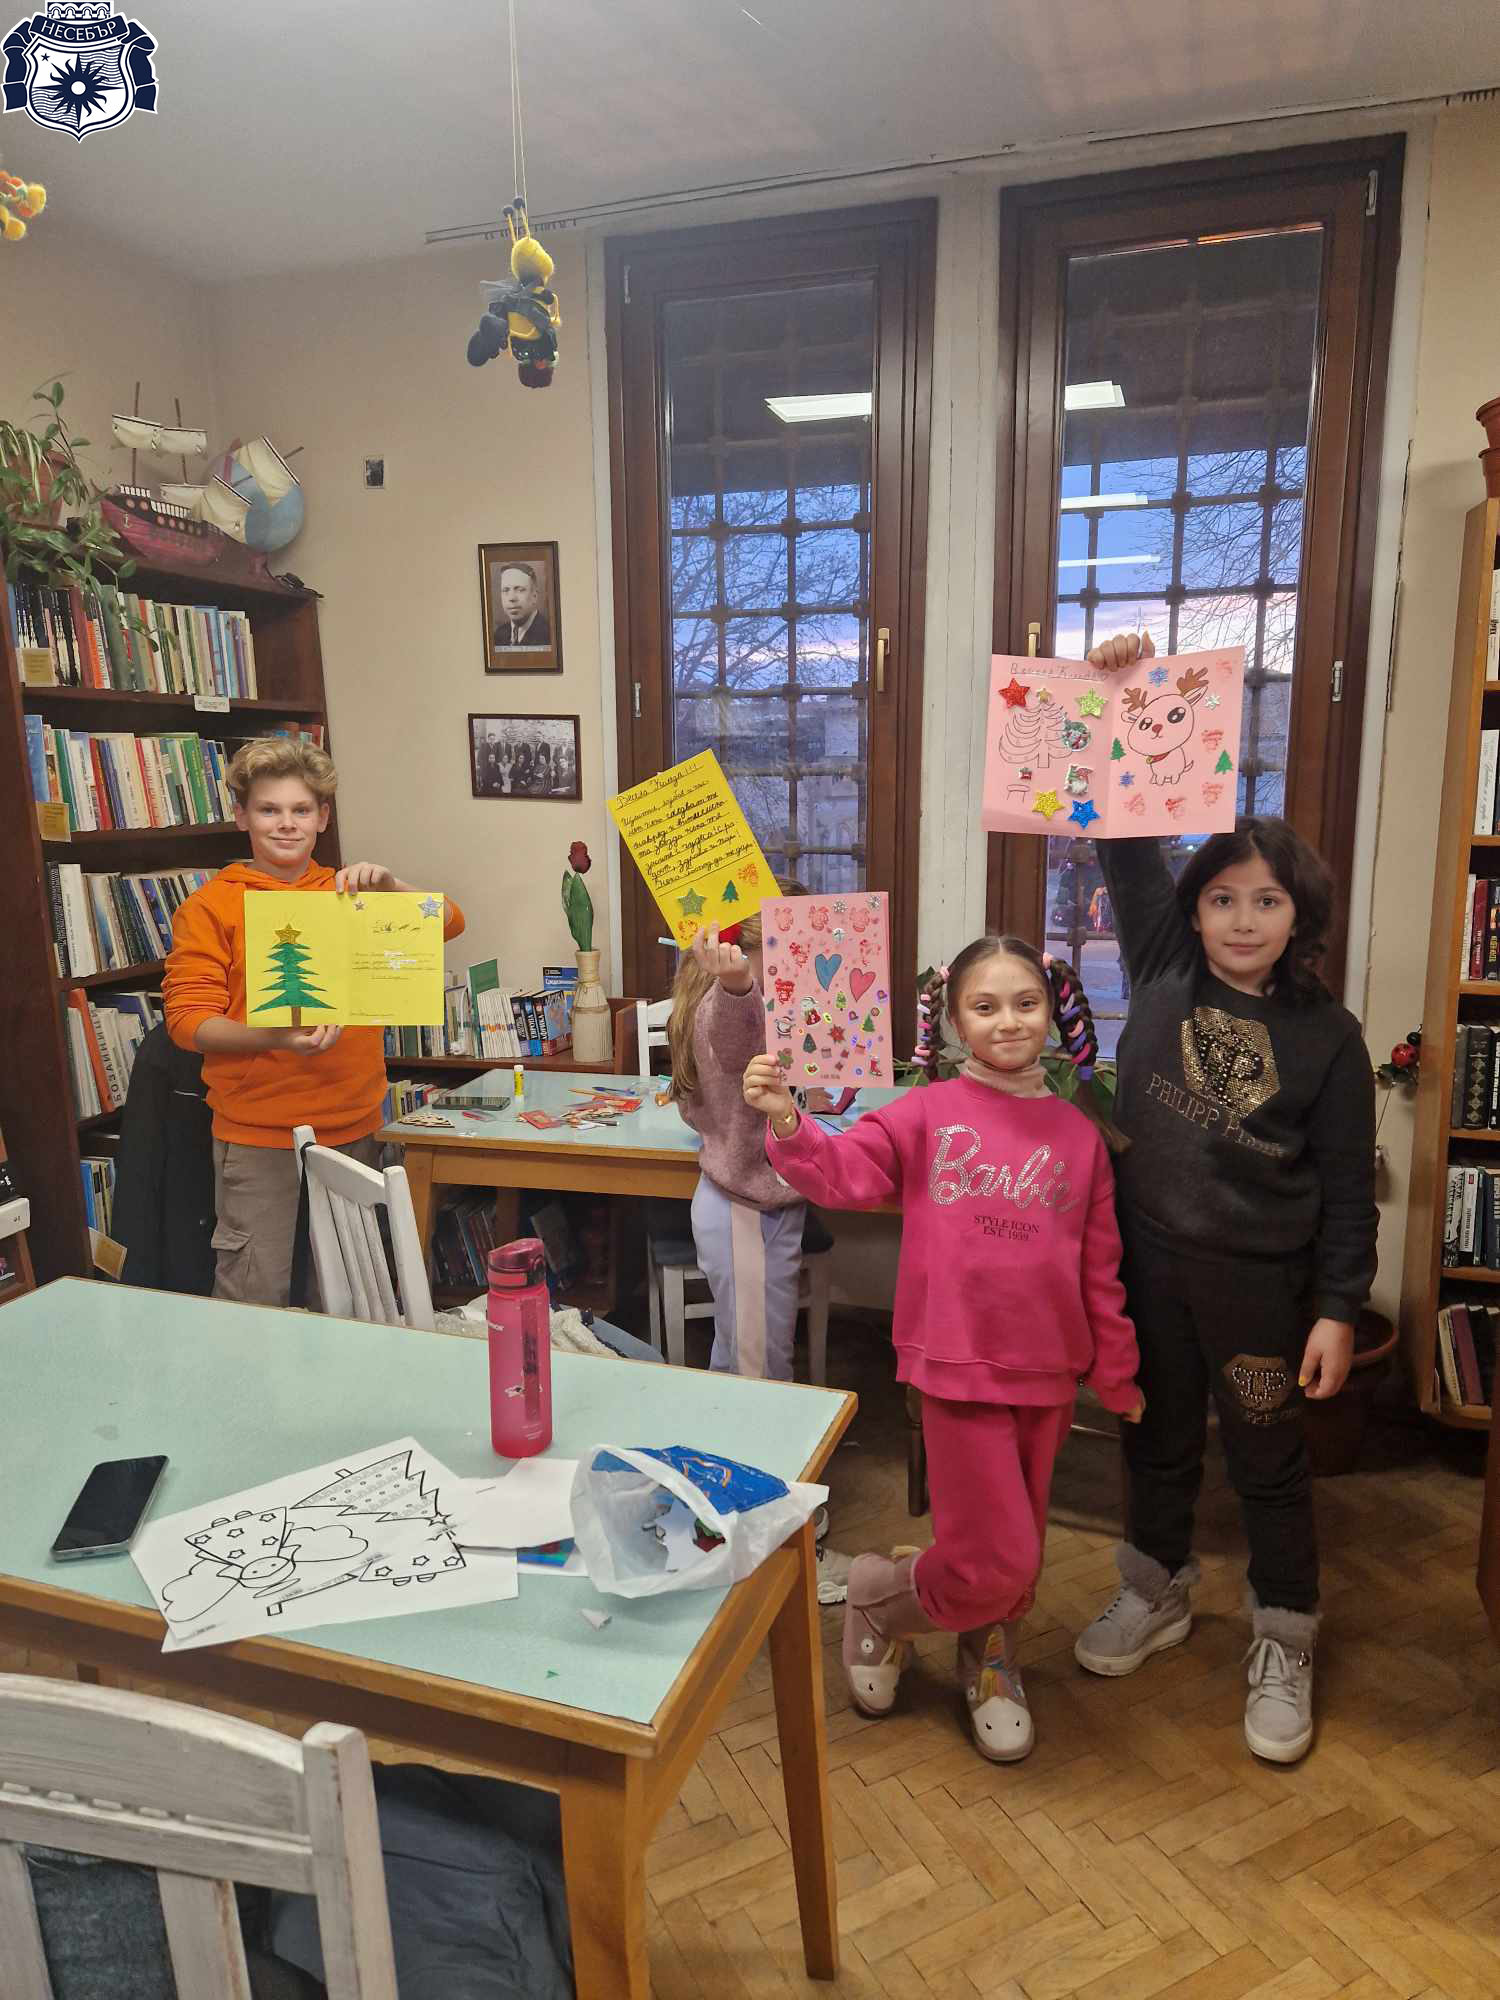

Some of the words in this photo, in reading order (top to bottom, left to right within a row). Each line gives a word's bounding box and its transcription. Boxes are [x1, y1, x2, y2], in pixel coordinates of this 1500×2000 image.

[1145, 1072, 1220, 1129] PHILIPP
[975, 1215, 1009, 1228] STYLE
[1011, 1221, 1040, 1233] ICON
